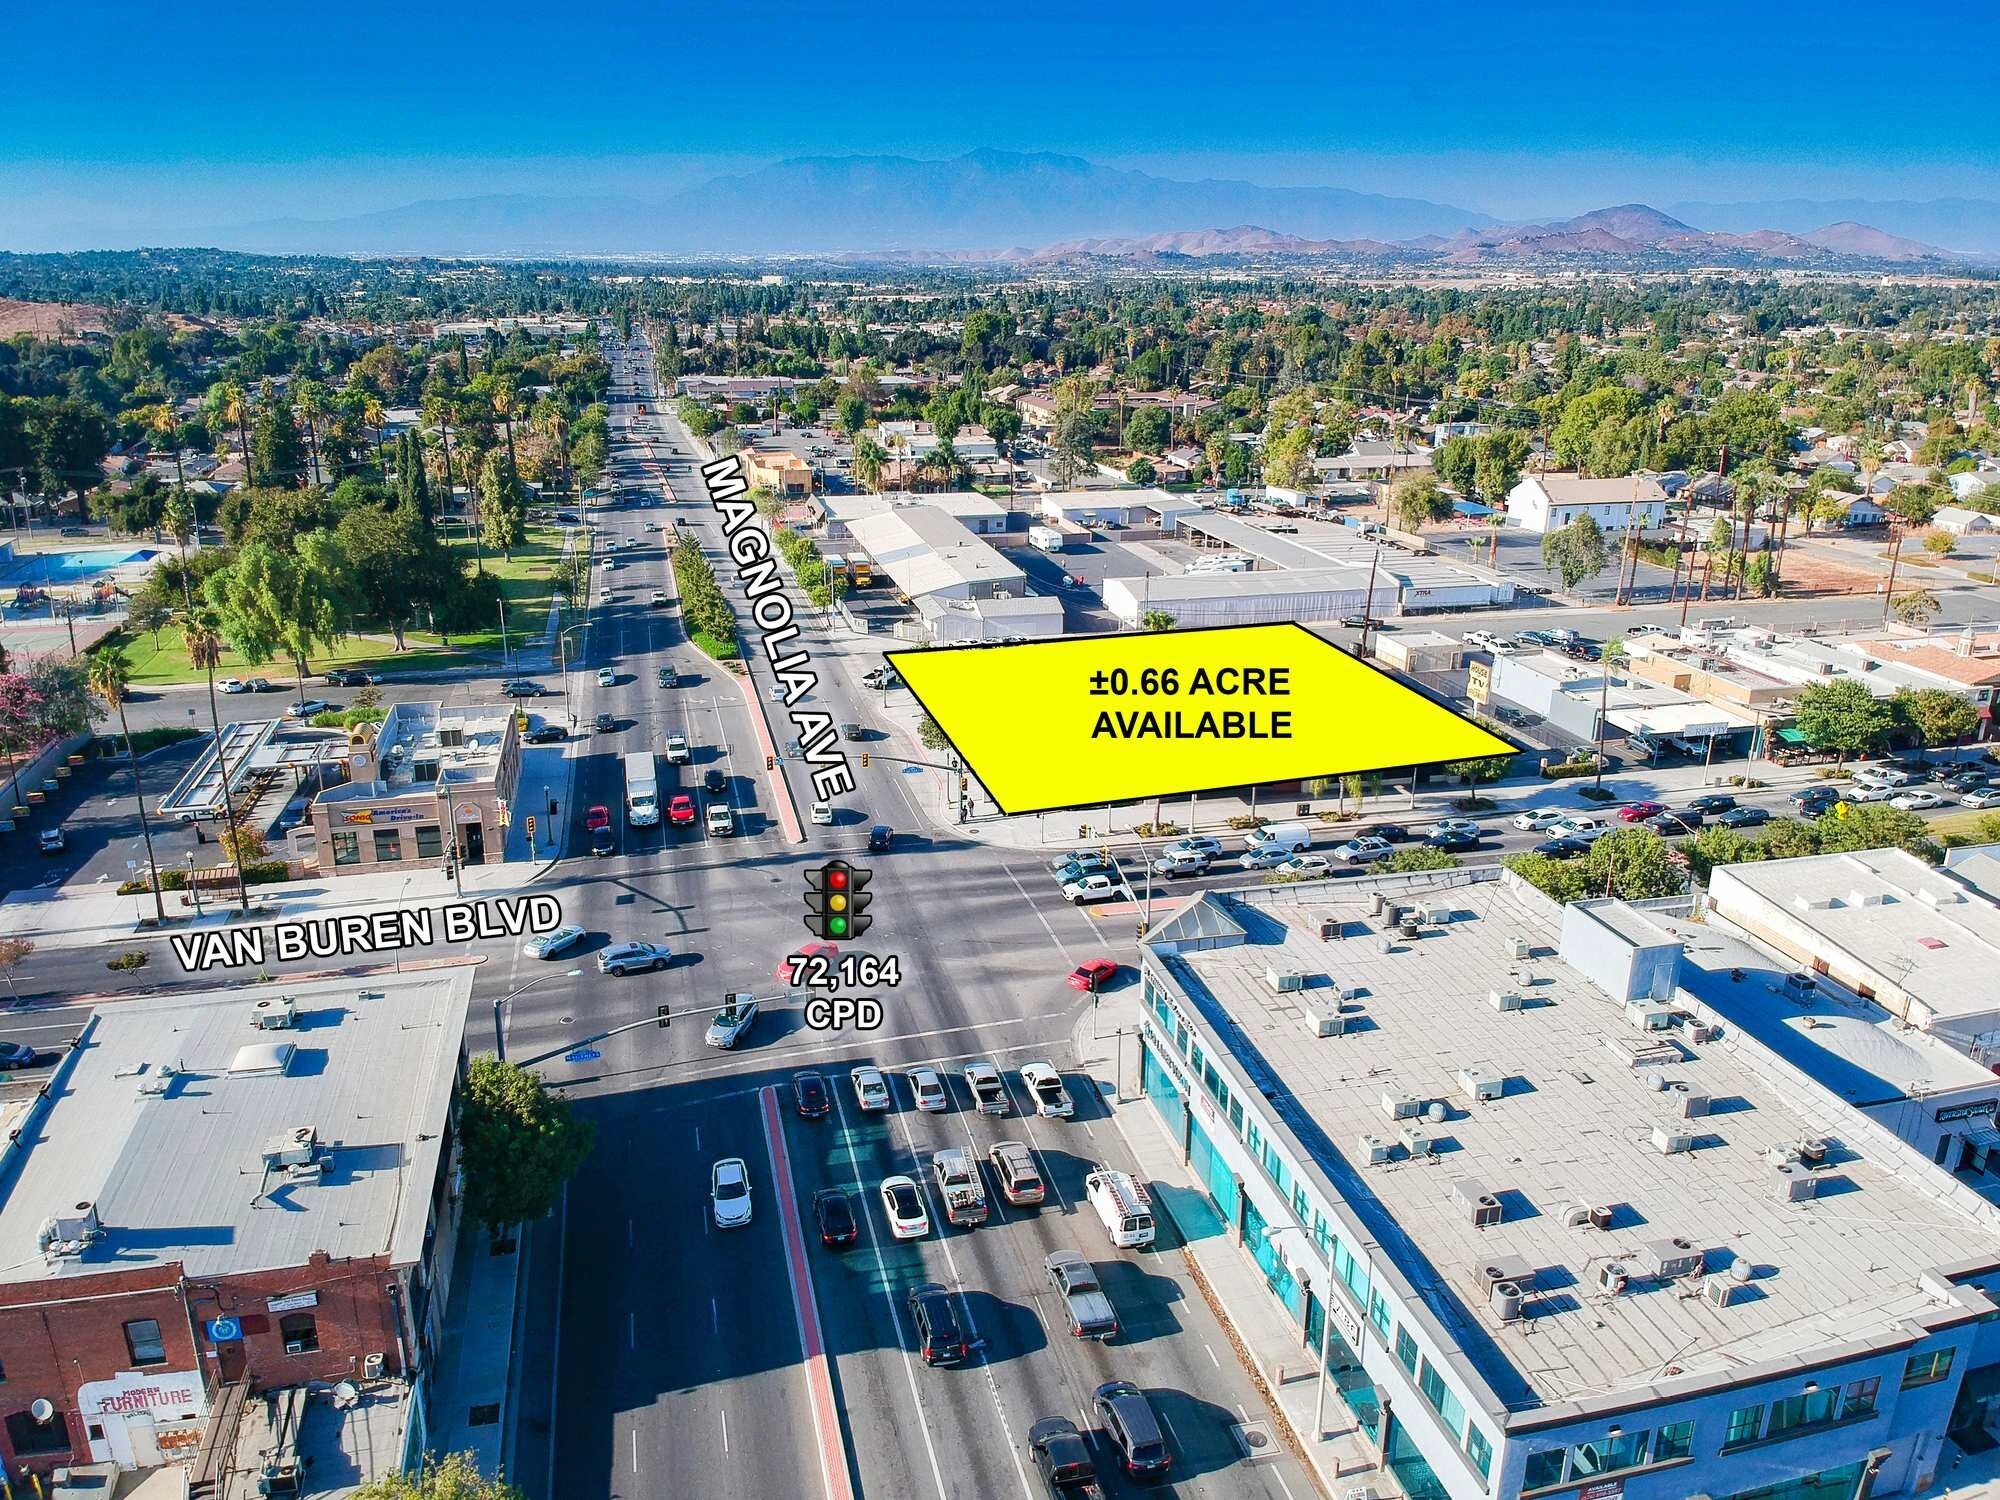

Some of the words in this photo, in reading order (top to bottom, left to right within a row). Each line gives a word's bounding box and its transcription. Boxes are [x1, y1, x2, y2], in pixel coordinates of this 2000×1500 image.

[1472, 676, 1485, 688] TV
[372, 807, 412, 816] America's
[122, 1386, 160, 1397] MODERN
[101, 1389, 193, 1411] FURNITURE
